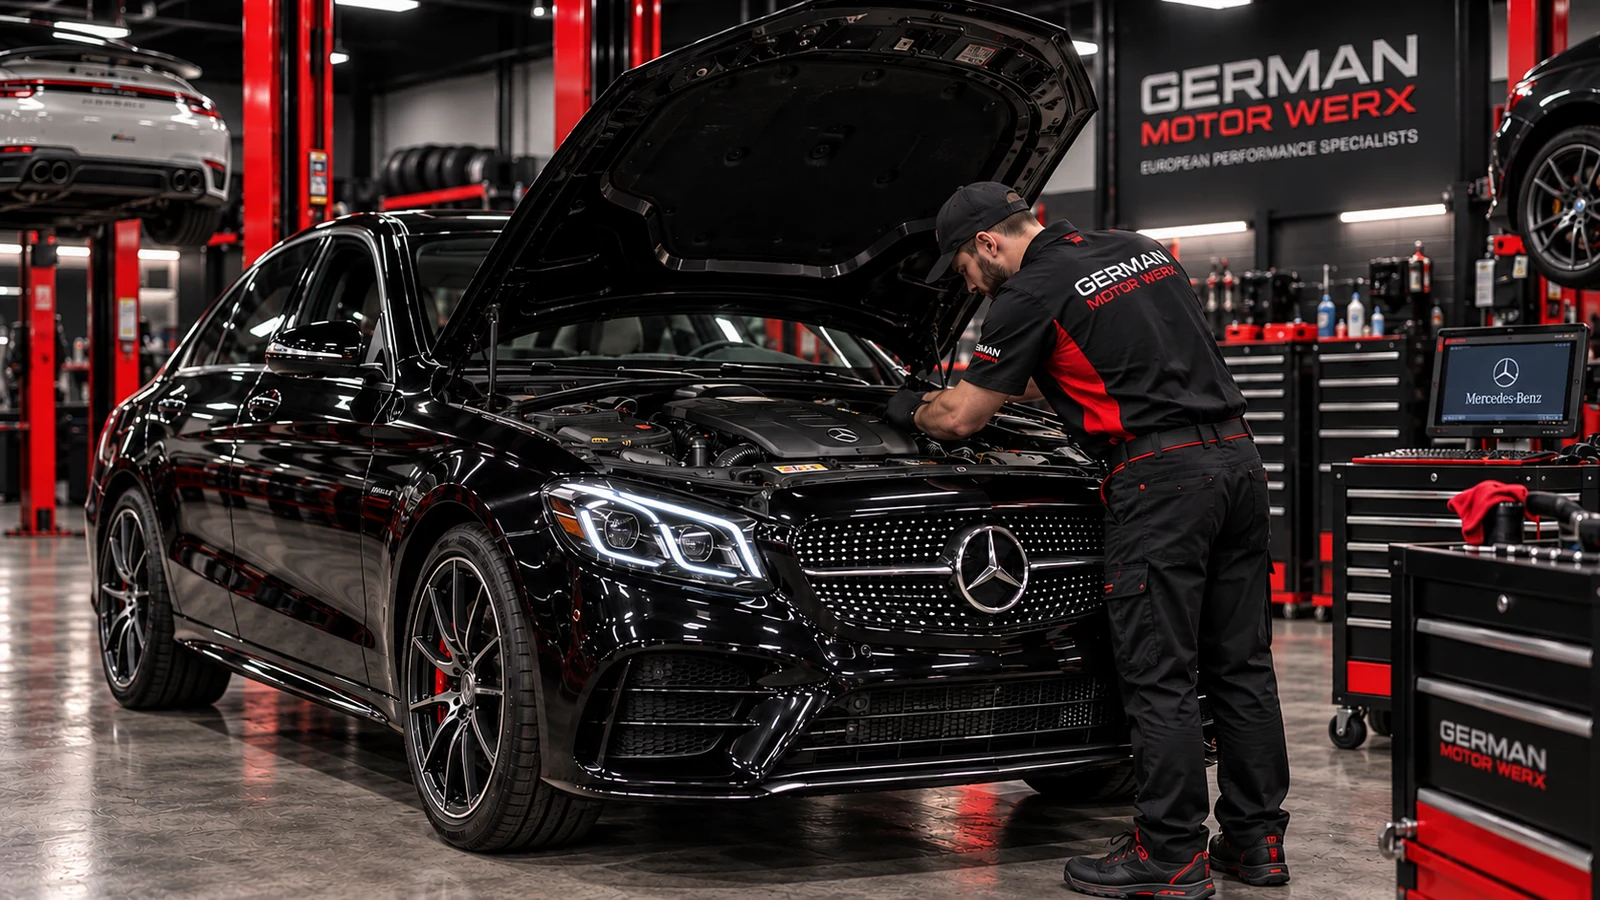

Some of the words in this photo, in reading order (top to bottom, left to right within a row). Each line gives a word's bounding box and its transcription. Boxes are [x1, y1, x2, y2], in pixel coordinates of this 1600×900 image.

[1140, 34, 1418, 115] GERMAN
[1141, 105, 1273, 146] MOTOR
[1284, 85, 1416, 128] WERX
[1140, 153, 1210, 175] EUROPEAN
[1212, 140, 1316, 167] PERFORMANCE
[1320, 128, 1419, 153] SPECIALISTS
[1074, 250, 1170, 297] GERMAN
[1086, 278, 1140, 311] MOTOR
[1140, 265, 1178, 284] WERX
[1465, 392, 1542, 405] Mercedes-Benz
[1440, 719, 1546, 772] GERMAN
[1440, 742, 1492, 772] MOTOR
[1496, 759, 1547, 790] WERX
